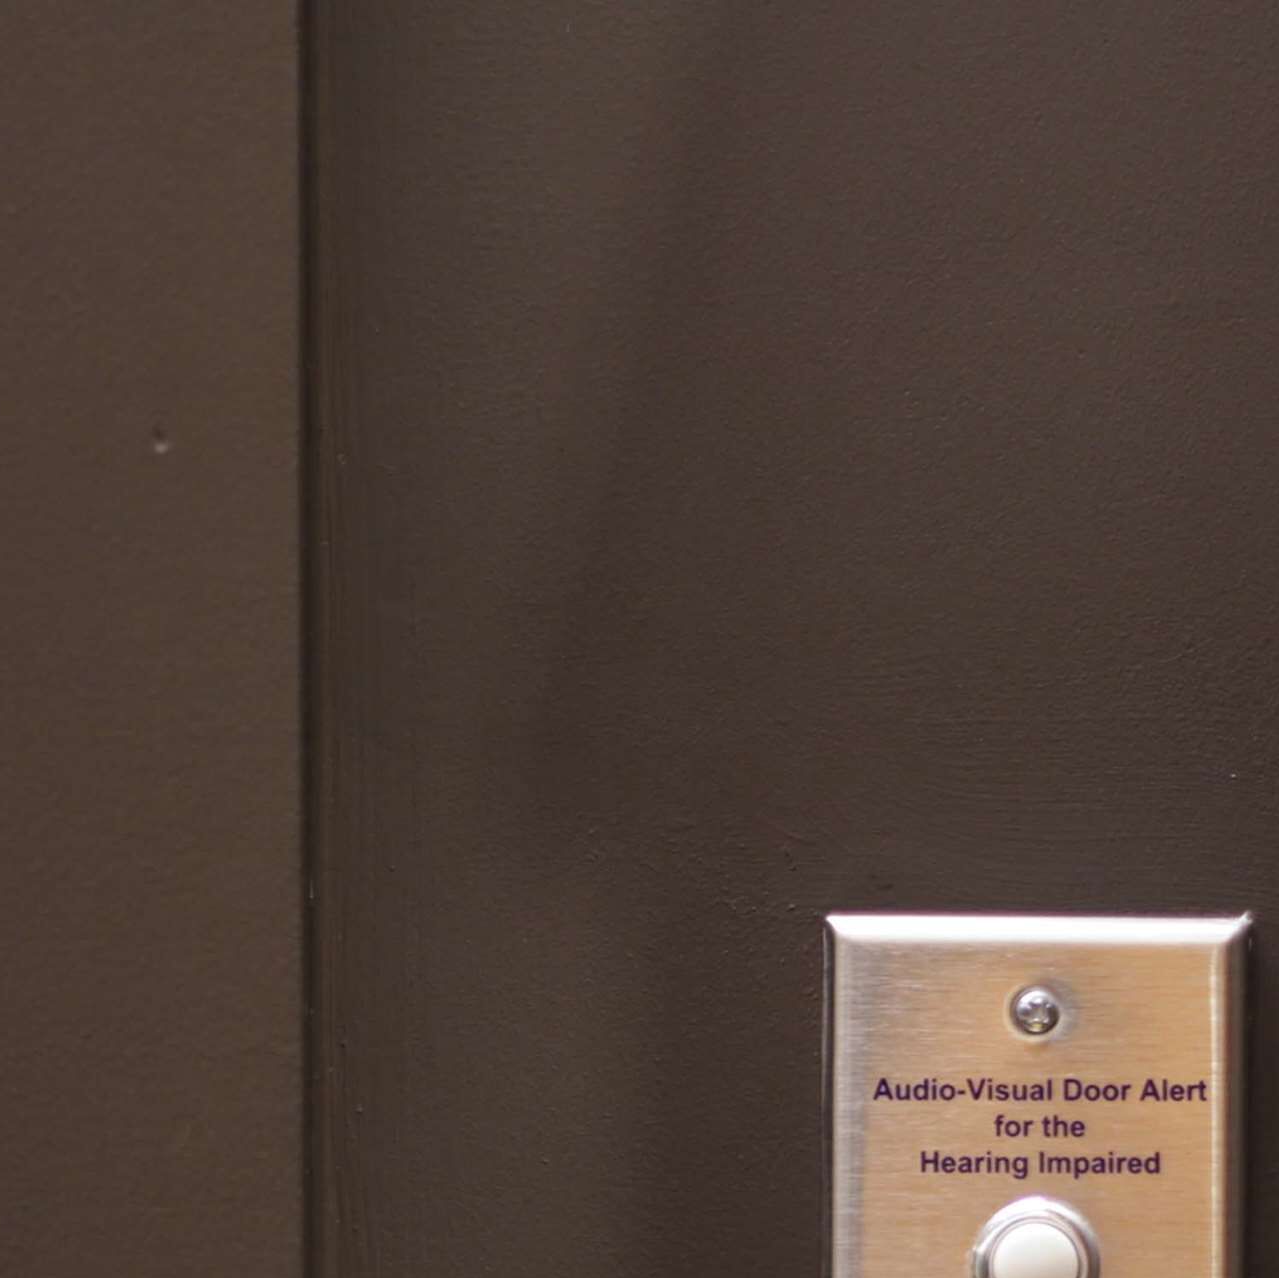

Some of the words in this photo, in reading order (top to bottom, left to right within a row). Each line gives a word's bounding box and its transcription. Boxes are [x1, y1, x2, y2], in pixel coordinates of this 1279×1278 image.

[872, 1077, 1053, 1102] Audio-Visual
[1063, 1078, 1132, 1102] Door
[1139, 1078, 1208, 1102] Alert
[993, 1114, 1035, 1138] for
[1041, 1114, 1086, 1138] the
[920, 1150, 1029, 1180] Hearing
[1038, 1151, 1161, 1180] Impaired
